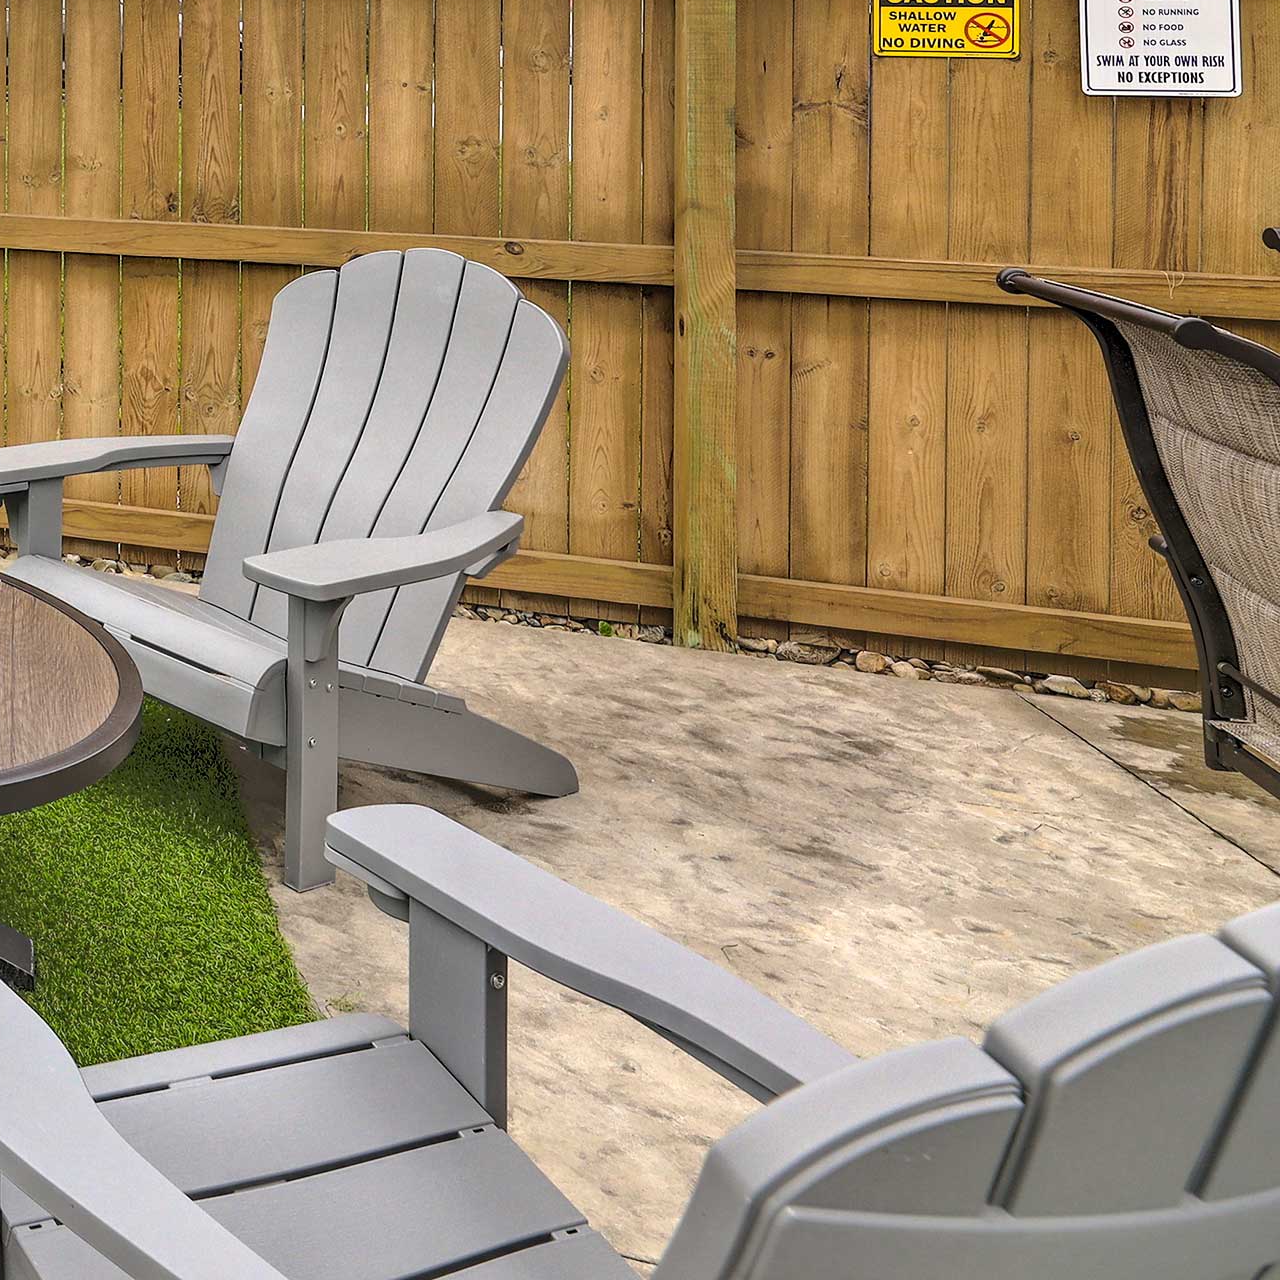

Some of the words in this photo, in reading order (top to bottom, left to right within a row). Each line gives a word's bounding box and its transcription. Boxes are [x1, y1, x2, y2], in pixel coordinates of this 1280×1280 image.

[889, 12, 956, 20] SHALLOW
[899, 24, 946, 32] WATER
[882, 38, 904, 47] NO
[910, 38, 965, 48] DIVING
[1097, 55, 1124, 66] SWIM
[1129, 56, 1140, 66] AT
[1144, 56, 1170, 66] YOUR
[1174, 56, 1198, 66] OWN
[1202, 56, 1225, 67] RISK
[1117, 72, 1133, 83] NO
[1139, 72, 1204, 83] EXCEPTIONS
